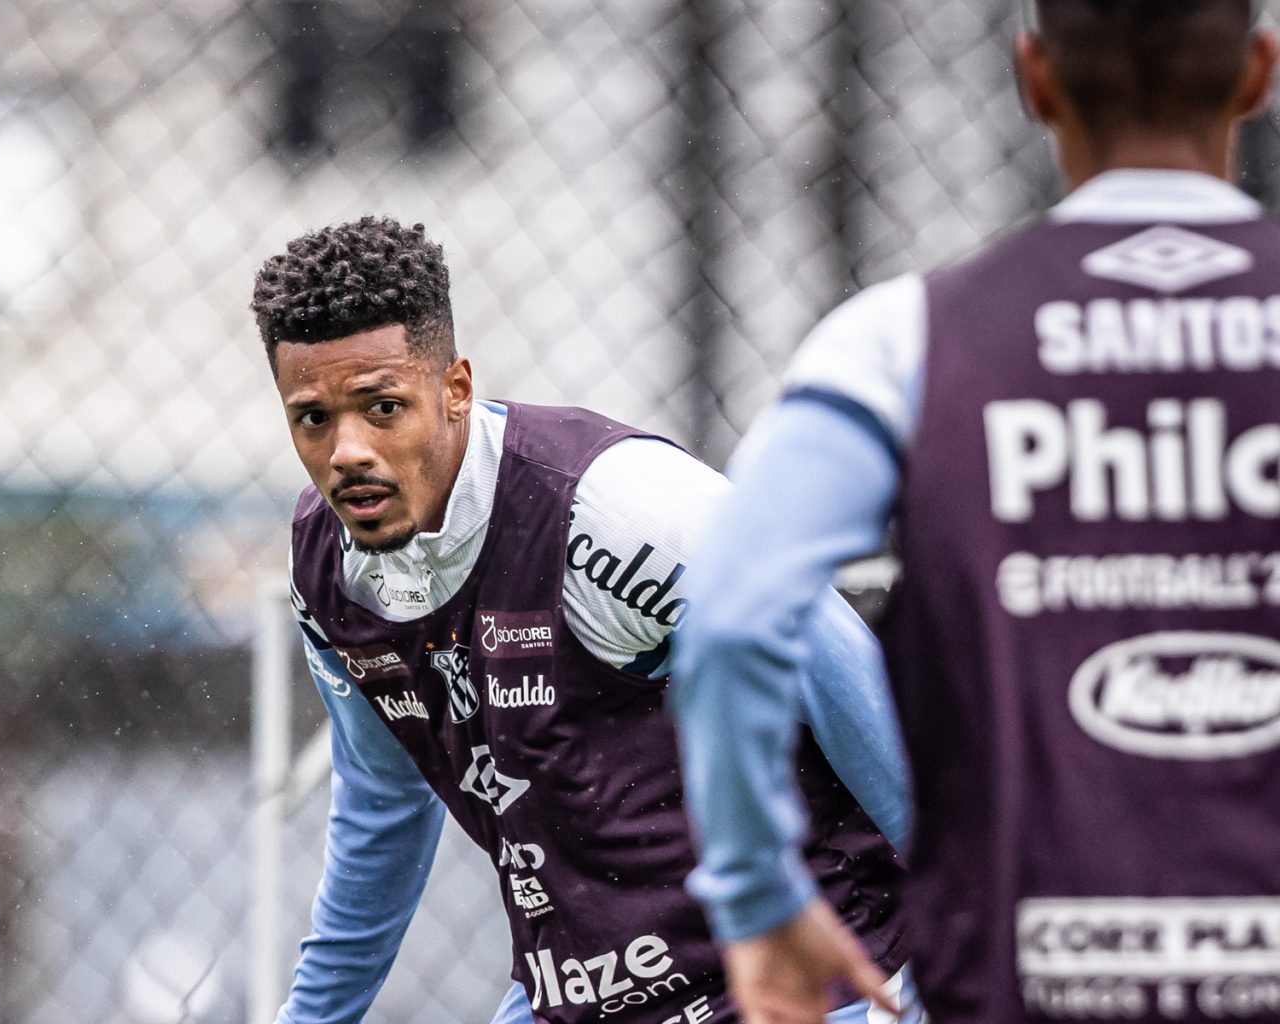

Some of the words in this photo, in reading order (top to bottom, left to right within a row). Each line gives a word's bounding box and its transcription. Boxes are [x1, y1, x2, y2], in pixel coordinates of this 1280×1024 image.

[983, 399, 1280, 521] Philc
[566, 510, 689, 630] caldo
[486, 674, 555, 708] Kicaldo
[599, 972, 692, 1019] .com
